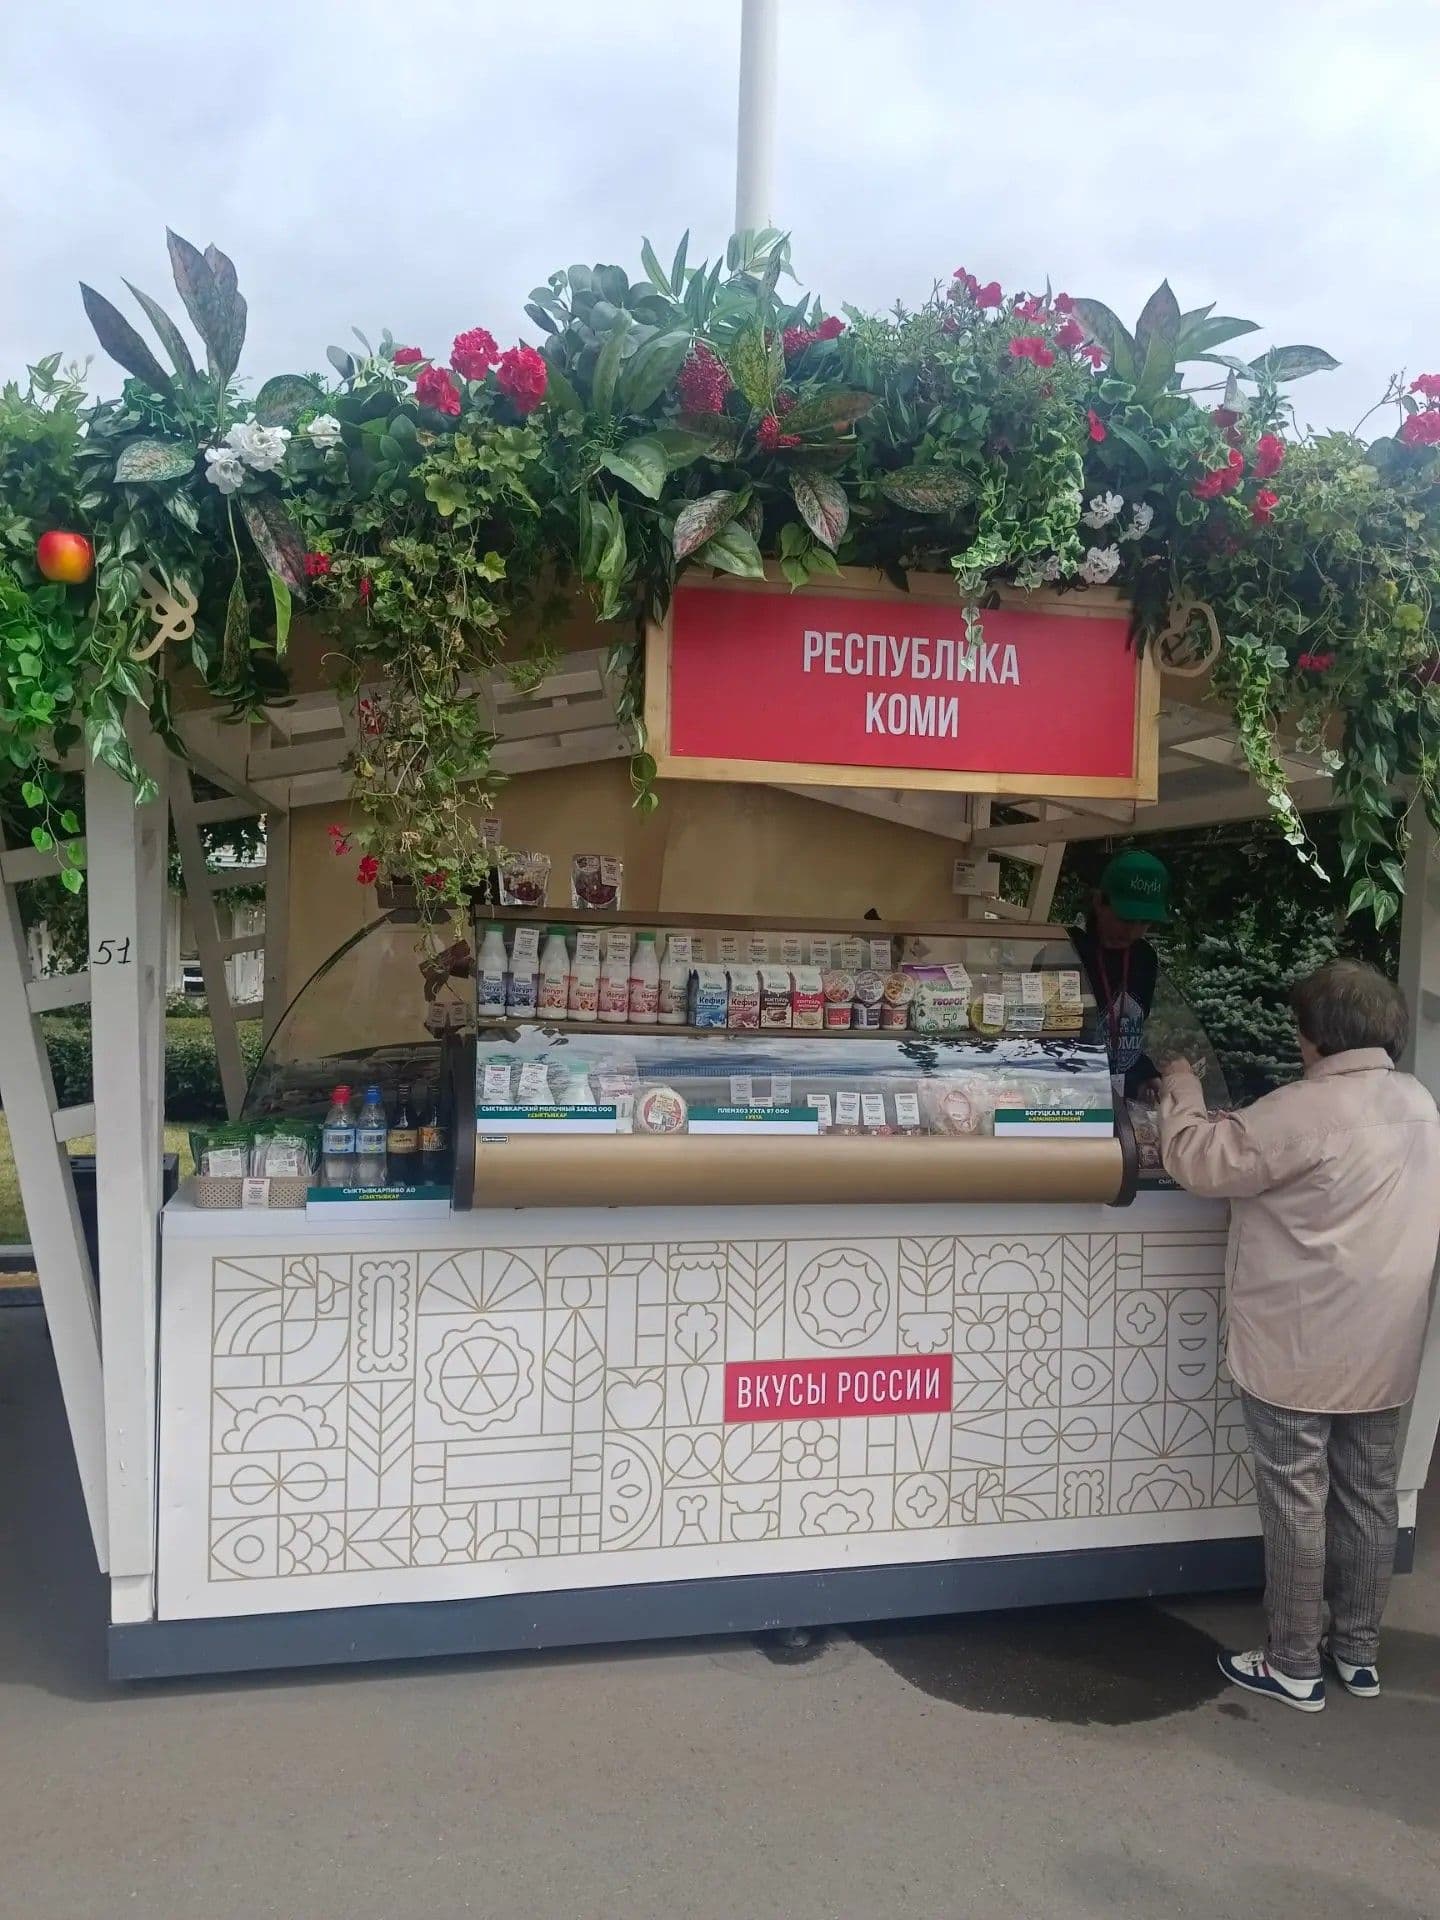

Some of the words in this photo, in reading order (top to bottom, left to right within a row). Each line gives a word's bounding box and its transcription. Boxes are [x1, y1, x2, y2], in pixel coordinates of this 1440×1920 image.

[803, 631, 1021, 686] РЕСПУБЛИКА
[865, 692, 959, 739] КОМИ
[92, 936, 131, 965] 51
[699, 996, 726, 1005] Кефир
[731, 998, 758, 1007] Кефир
[737, 1372, 827, 1409] ВКУСЫ
[838, 1367, 941, 1404] РОССИИ
